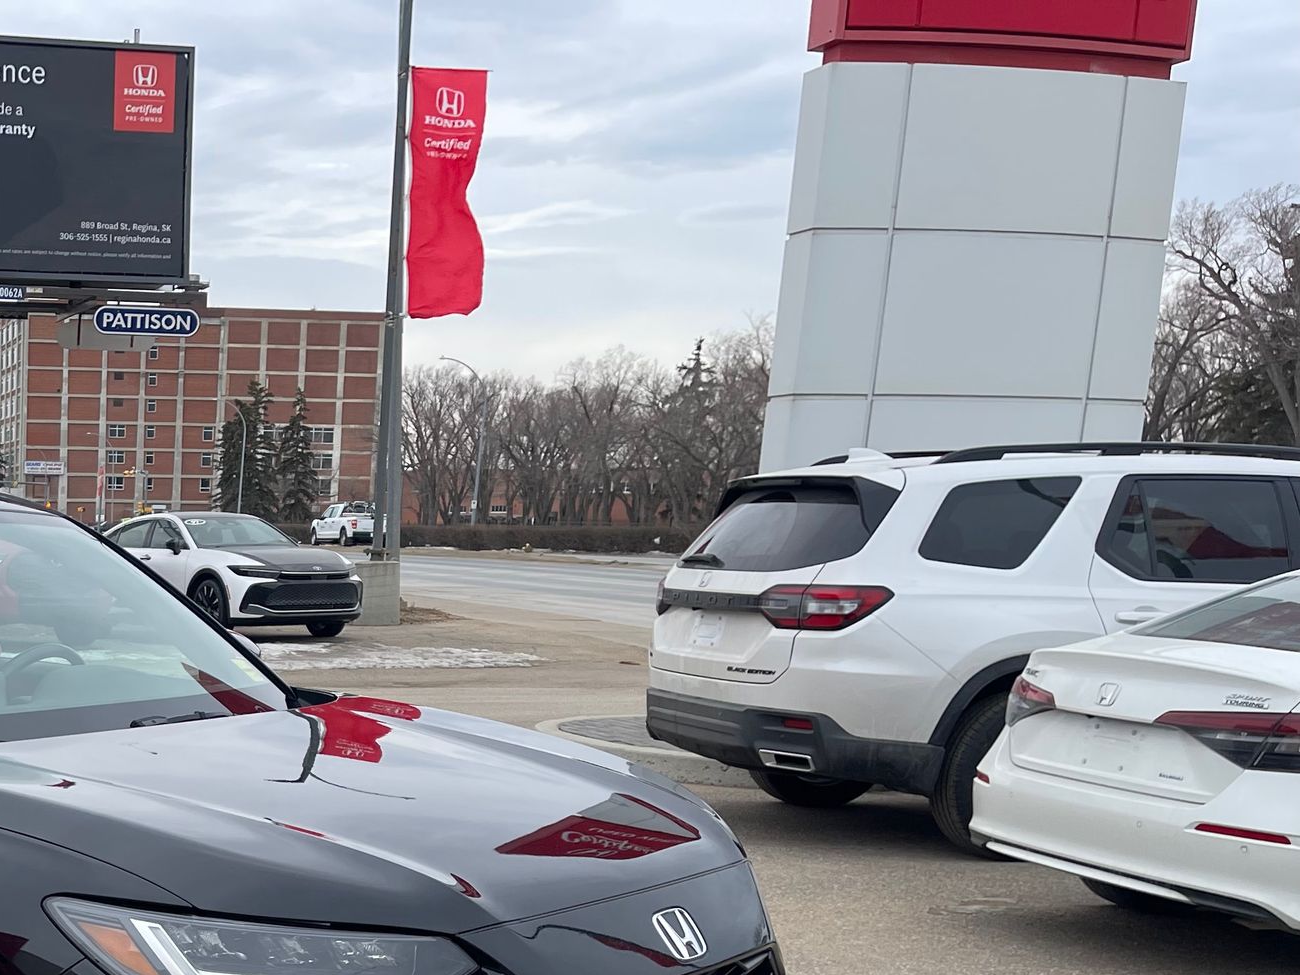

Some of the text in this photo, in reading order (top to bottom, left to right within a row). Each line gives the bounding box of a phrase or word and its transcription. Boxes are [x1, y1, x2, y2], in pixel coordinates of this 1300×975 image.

[124, 88, 166, 97] HONDA
[15, 105, 23, 116] a
[125, 104, 164, 116] Certified
[424, 115, 476, 128] HONDA
[424, 138, 472, 151] Certified
[81, 221, 95, 229] 889
[97, 222, 118, 230] Broad
[162, 224, 172, 232] SK
[60, 233, 108, 242] 306-525-1555
[114, 234, 171, 244] reginahonda.ca
[102, 312, 191, 331] PATTISON
[673, 593, 735, 605] PILOT
